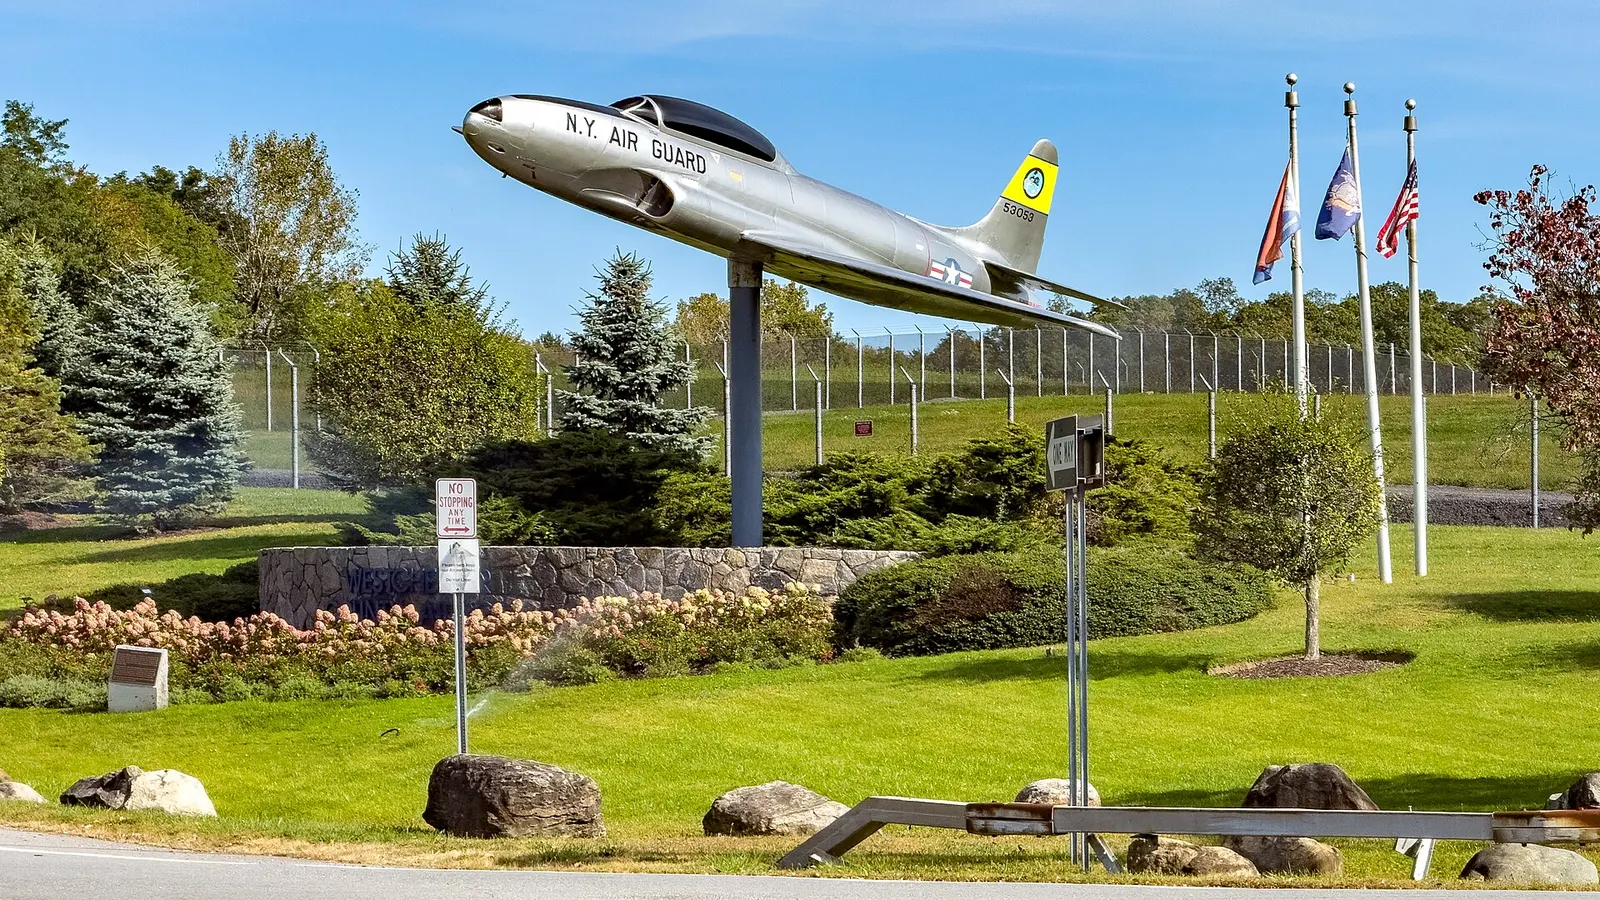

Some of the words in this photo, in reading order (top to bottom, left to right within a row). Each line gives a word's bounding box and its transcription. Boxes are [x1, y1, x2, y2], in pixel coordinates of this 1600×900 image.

[566, 112, 597, 139] N.Y.
[608, 126, 639, 152] AIR
[652, 139, 706, 175] GUARD
[1003, 202, 1035, 223] 53053
[1052, 442, 1062, 466] ONE
[1063, 440, 1074, 463] WAY
[448, 483, 463, 494] NO
[440, 496, 473, 508] STOPPING
